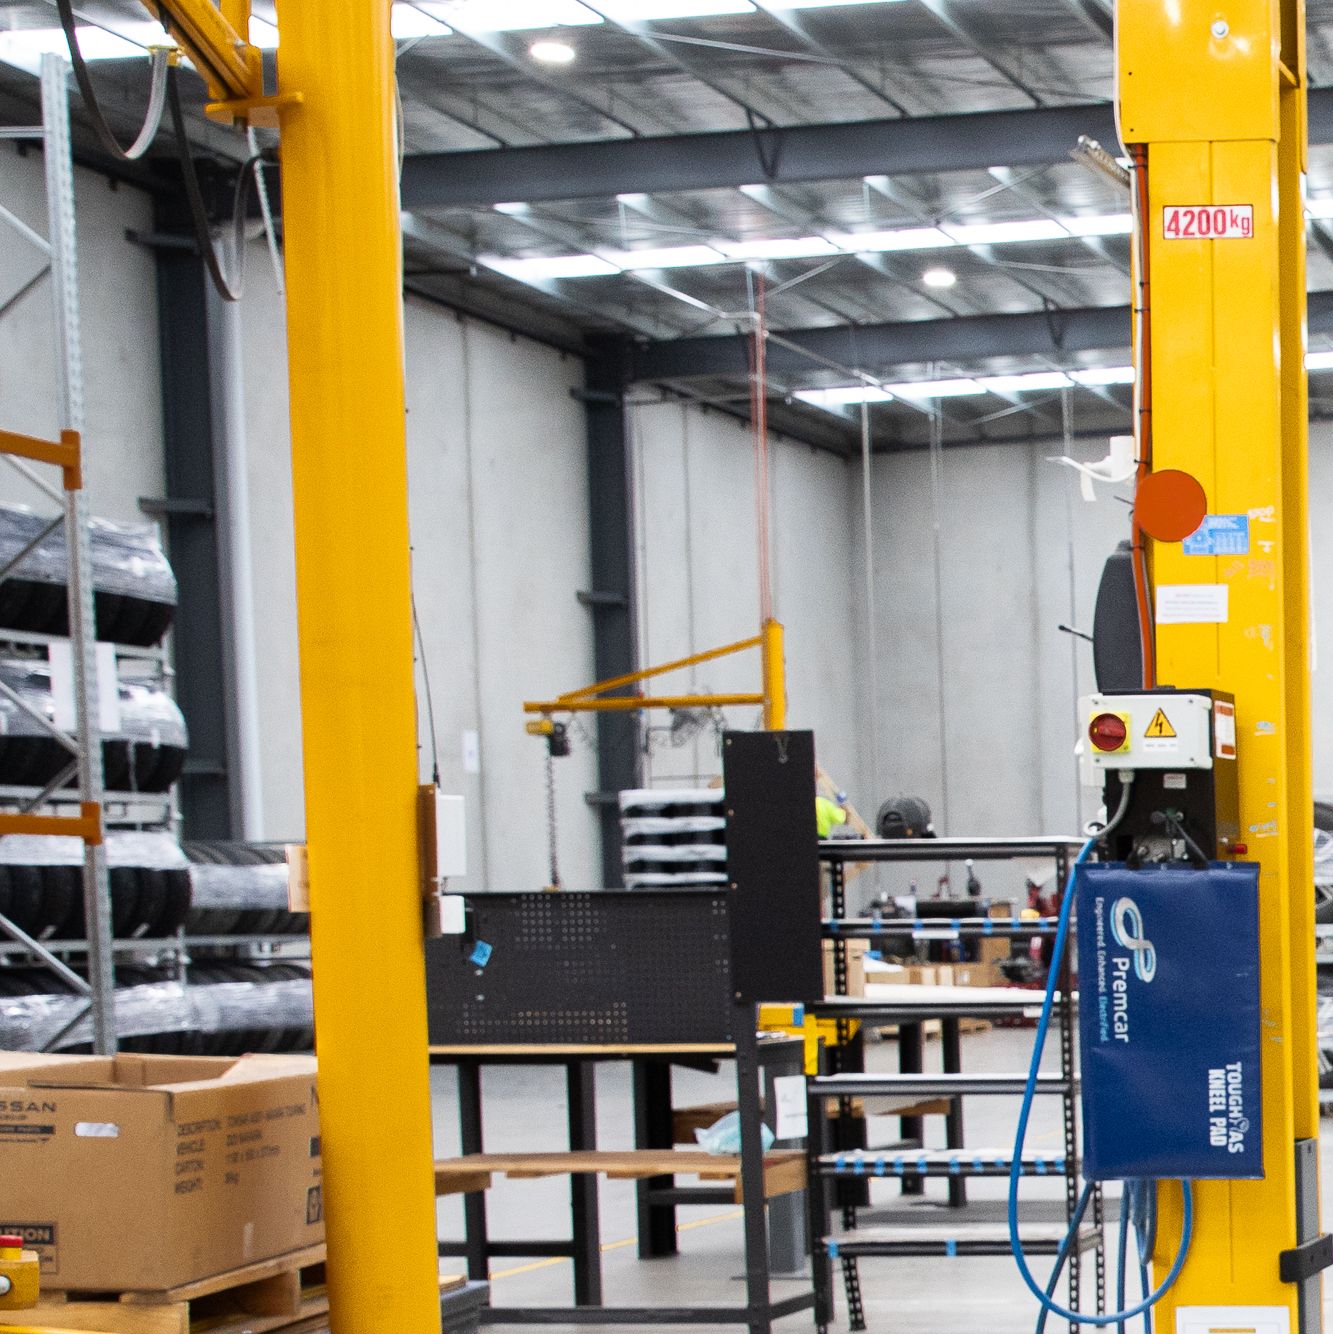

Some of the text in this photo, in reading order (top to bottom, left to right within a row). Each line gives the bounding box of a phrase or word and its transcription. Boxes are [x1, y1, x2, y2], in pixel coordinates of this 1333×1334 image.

[1112, 957, 1130, 1043] Premcar
[1208, 1068, 1227, 1146] KNEEL PAD
